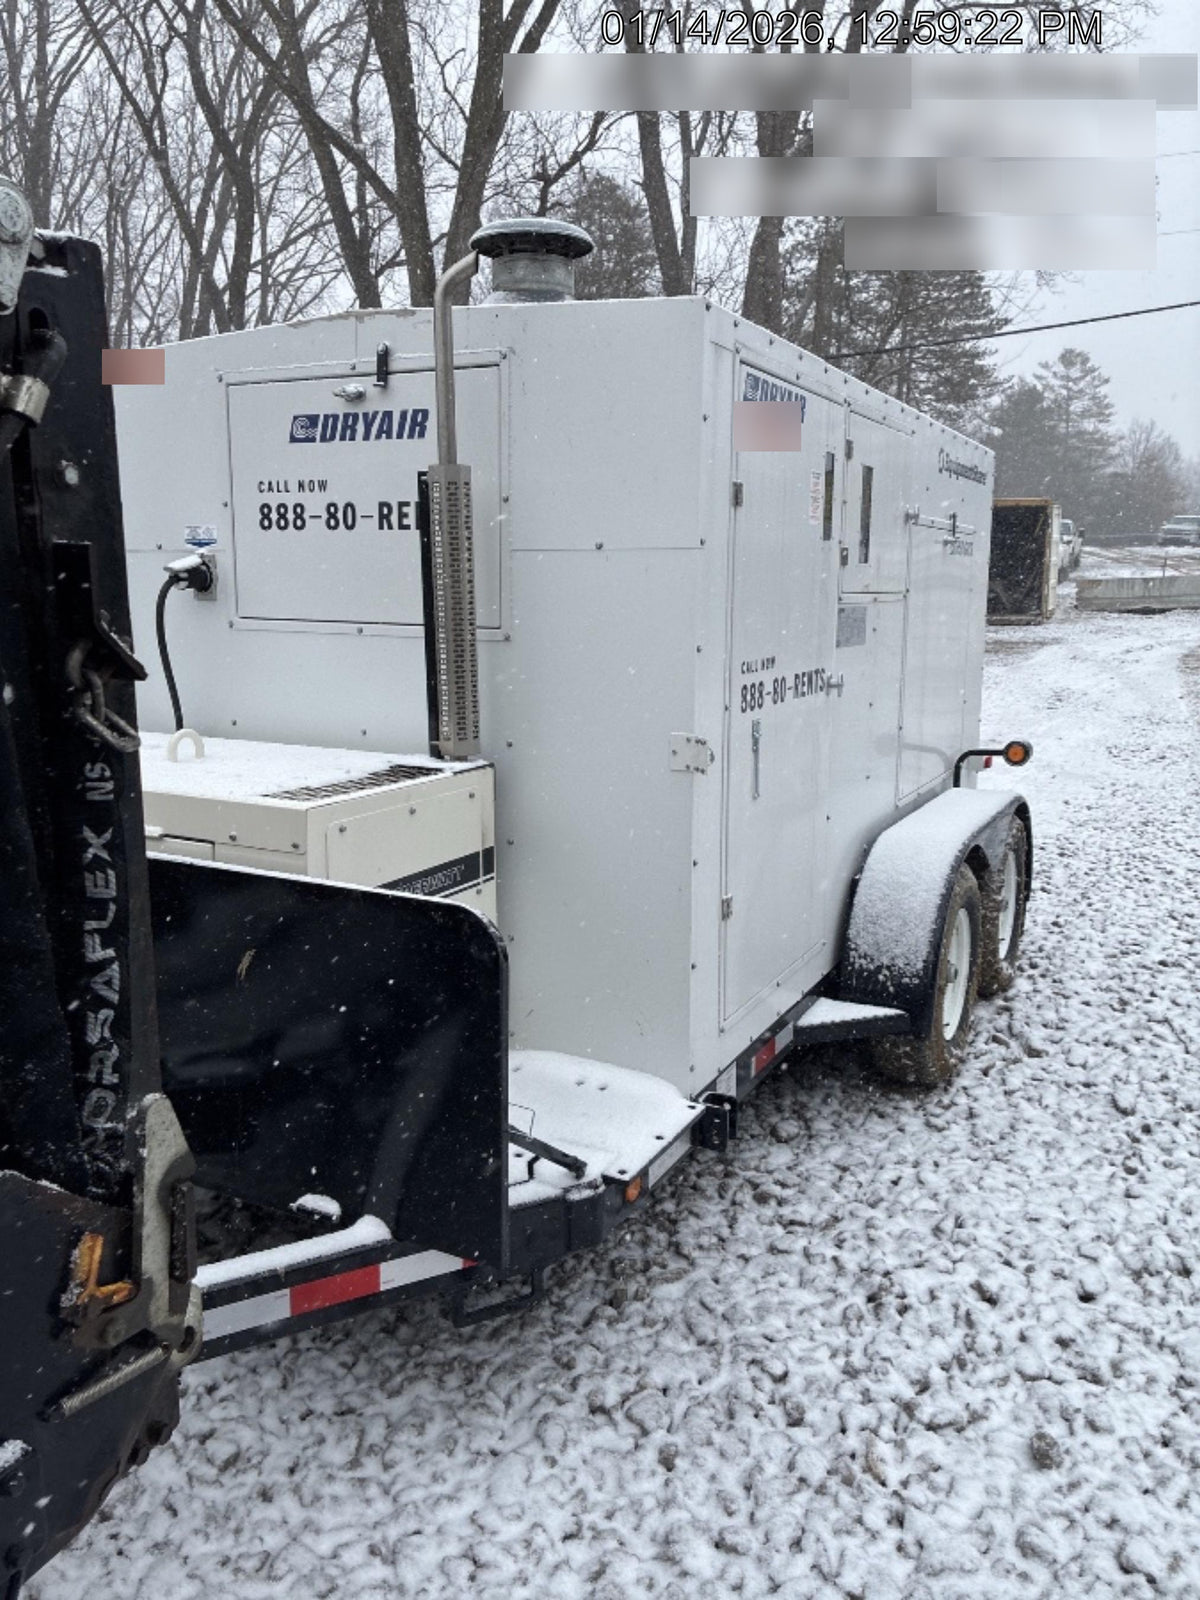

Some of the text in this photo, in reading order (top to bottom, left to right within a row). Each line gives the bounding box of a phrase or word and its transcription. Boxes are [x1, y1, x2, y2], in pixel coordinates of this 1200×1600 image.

[318, 408, 430, 443] DRYAIR
[257, 479, 328, 494] CALL NOW
[258, 501, 420, 532] 888-80-RE
[741, 660, 758, 674] CALL
[740, 667, 826, 714] 888-80-RENTS
